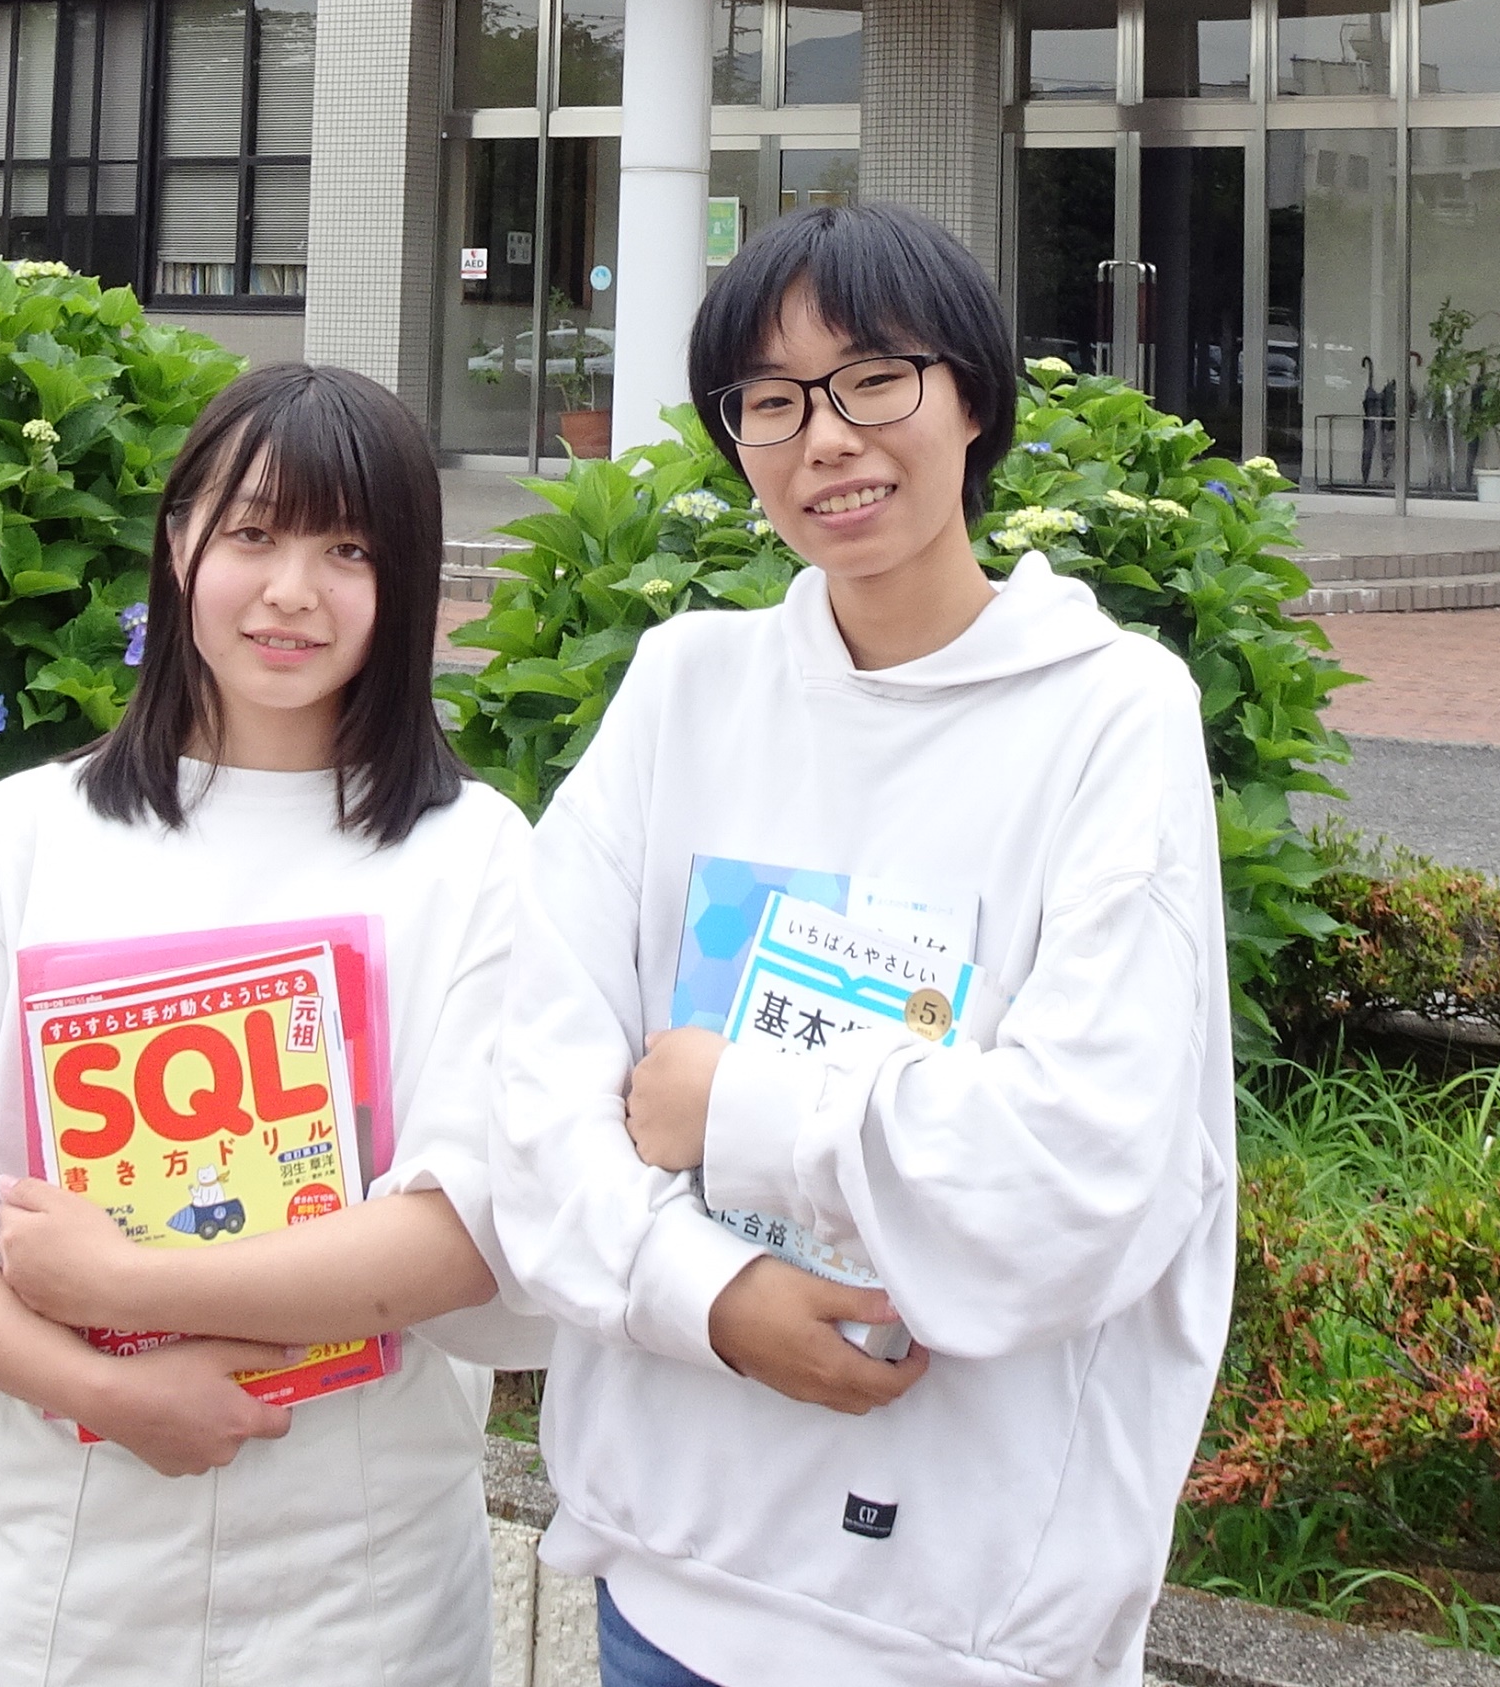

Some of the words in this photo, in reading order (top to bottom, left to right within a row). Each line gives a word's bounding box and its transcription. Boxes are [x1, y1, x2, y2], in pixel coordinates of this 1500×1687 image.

[464, 258, 485, 268] AED
[788, 919, 936, 984] いちばんやさしい
[49, 974, 309, 1041] すらすらと手が動くようになる
[291, 999, 321, 1049] 元祖
[754, 990, 873, 1051] 基本
[919, 1000, 938, 1026] 5
[52, 1008, 330, 1160] SQL
[63, 1120, 333, 1193] 書き方ドリル
